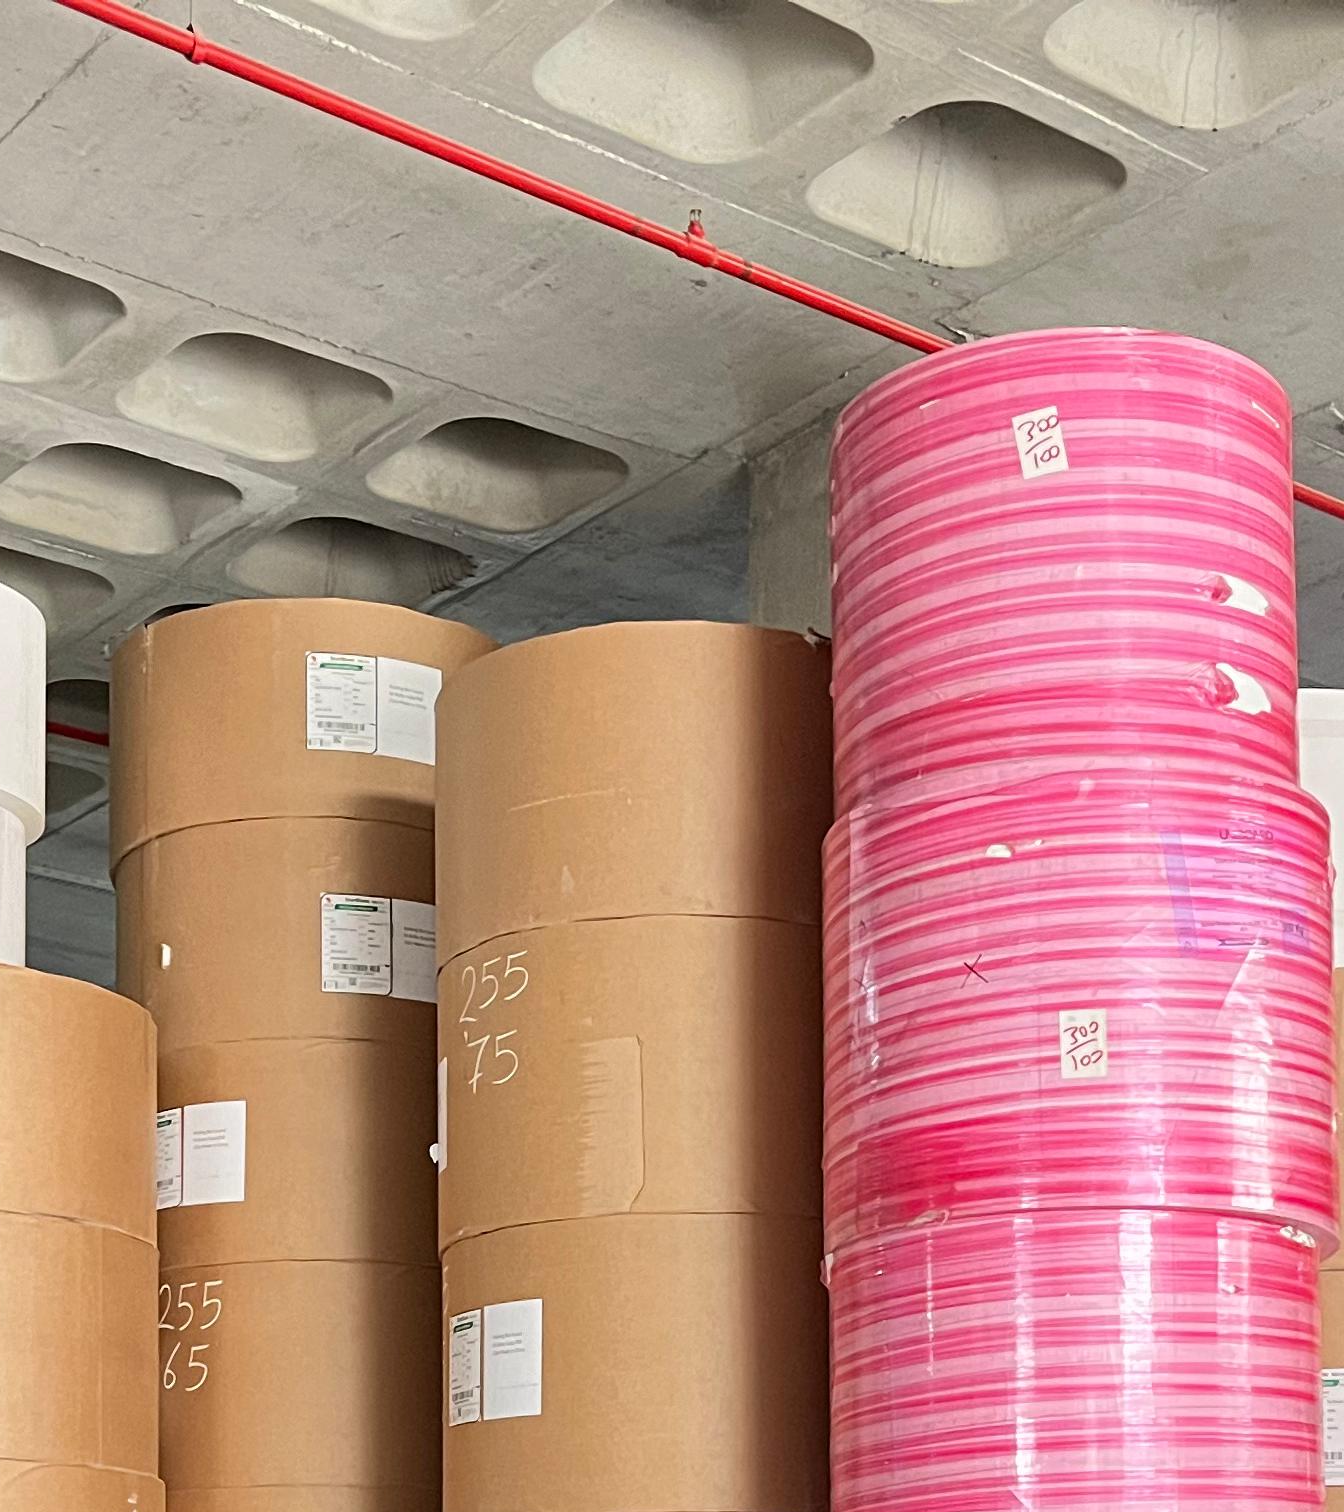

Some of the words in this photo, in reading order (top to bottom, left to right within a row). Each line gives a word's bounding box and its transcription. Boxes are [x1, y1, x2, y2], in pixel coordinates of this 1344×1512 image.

[1017, 415, 1060, 442] 300
[1033, 445, 1060, 469] 100
[459, 950, 529, 1024] 255
[1063, 1021, 1099, 1045] 300
[463, 1030, 519, 1095] 75
[1071, 1049, 1104, 1071] 100
[158, 1280, 223, 1331] 255
[163, 1341, 210, 1391] 65
